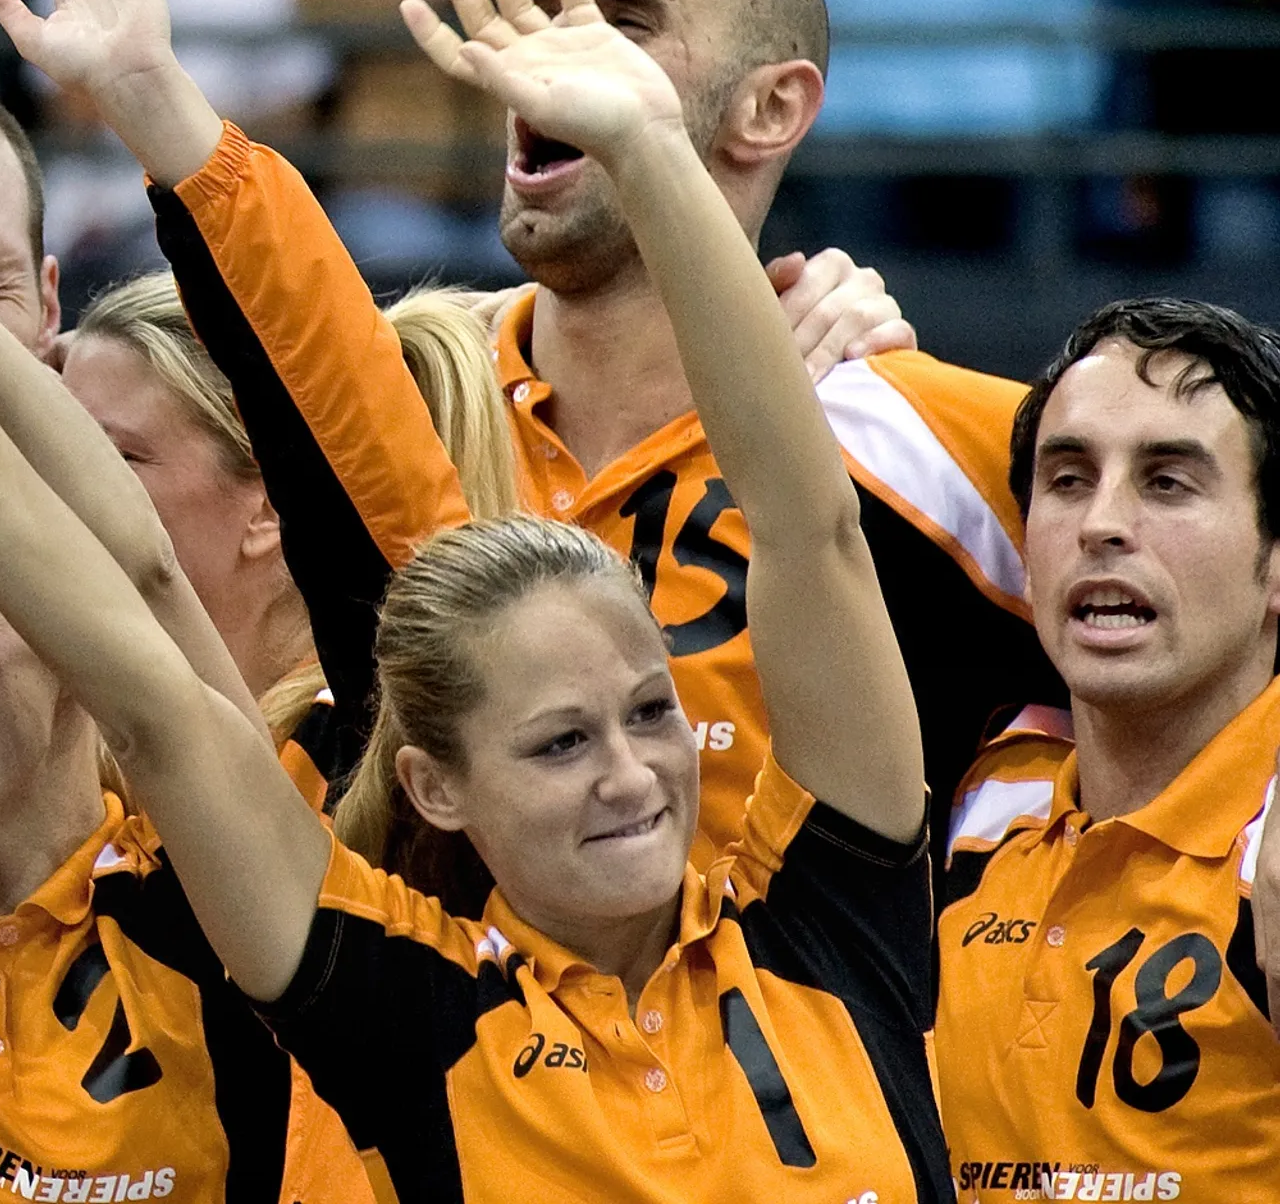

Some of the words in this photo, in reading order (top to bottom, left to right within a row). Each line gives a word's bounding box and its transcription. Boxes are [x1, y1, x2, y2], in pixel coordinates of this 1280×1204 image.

[619, 469, 750, 658] 15
[53, 942, 163, 1104] 2
[719, 986, 817, 1168] 1
[1076, 927, 1223, 1114] 18
[11, 1167, 176, 1203] SPIEREN
[50, 1167, 87, 1181] VOOR
[1041, 1172, 1183, 1202] SPIEREN
